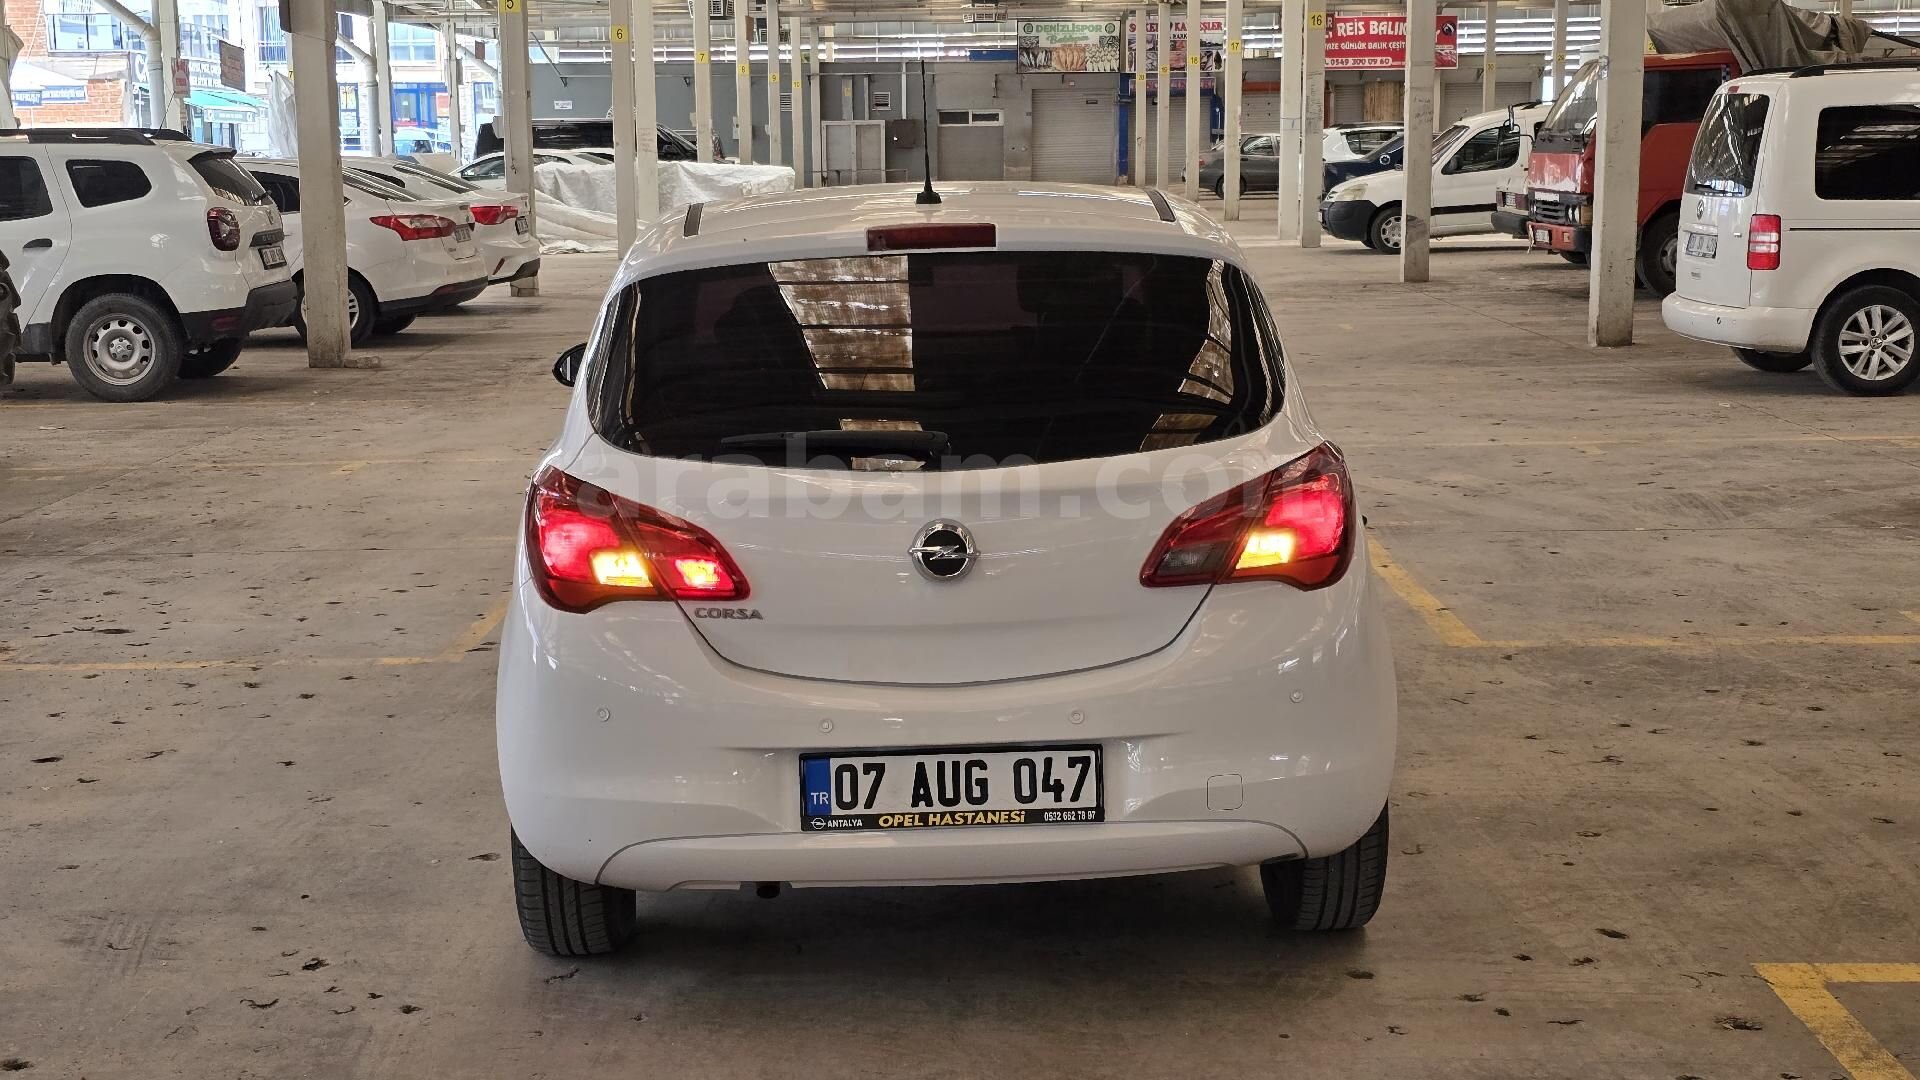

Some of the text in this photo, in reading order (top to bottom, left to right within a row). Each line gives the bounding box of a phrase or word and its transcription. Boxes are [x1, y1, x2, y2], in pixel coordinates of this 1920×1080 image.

[1311, 15, 1322, 26] 16
[1036, 23, 1102, 33] DENİZLİSPOR
[1336, 19, 1365, 37] REİS
[616, 28, 623, 40] 6
[1231, 42, 1240, 51] 17
[1341, 41, 1367, 50] GÜNLÜK
[1368, 41, 1388, 50] BALIK
[1352, 58, 1367, 66] 300
[694, 607, 764, 621] CORSA
[835, 756, 1092, 811] 07 AUG 047
[810, 791, 829, 805] TR
[827, 818, 863, 829] ANTALYA
[878, 814, 923, 828] OPEL
